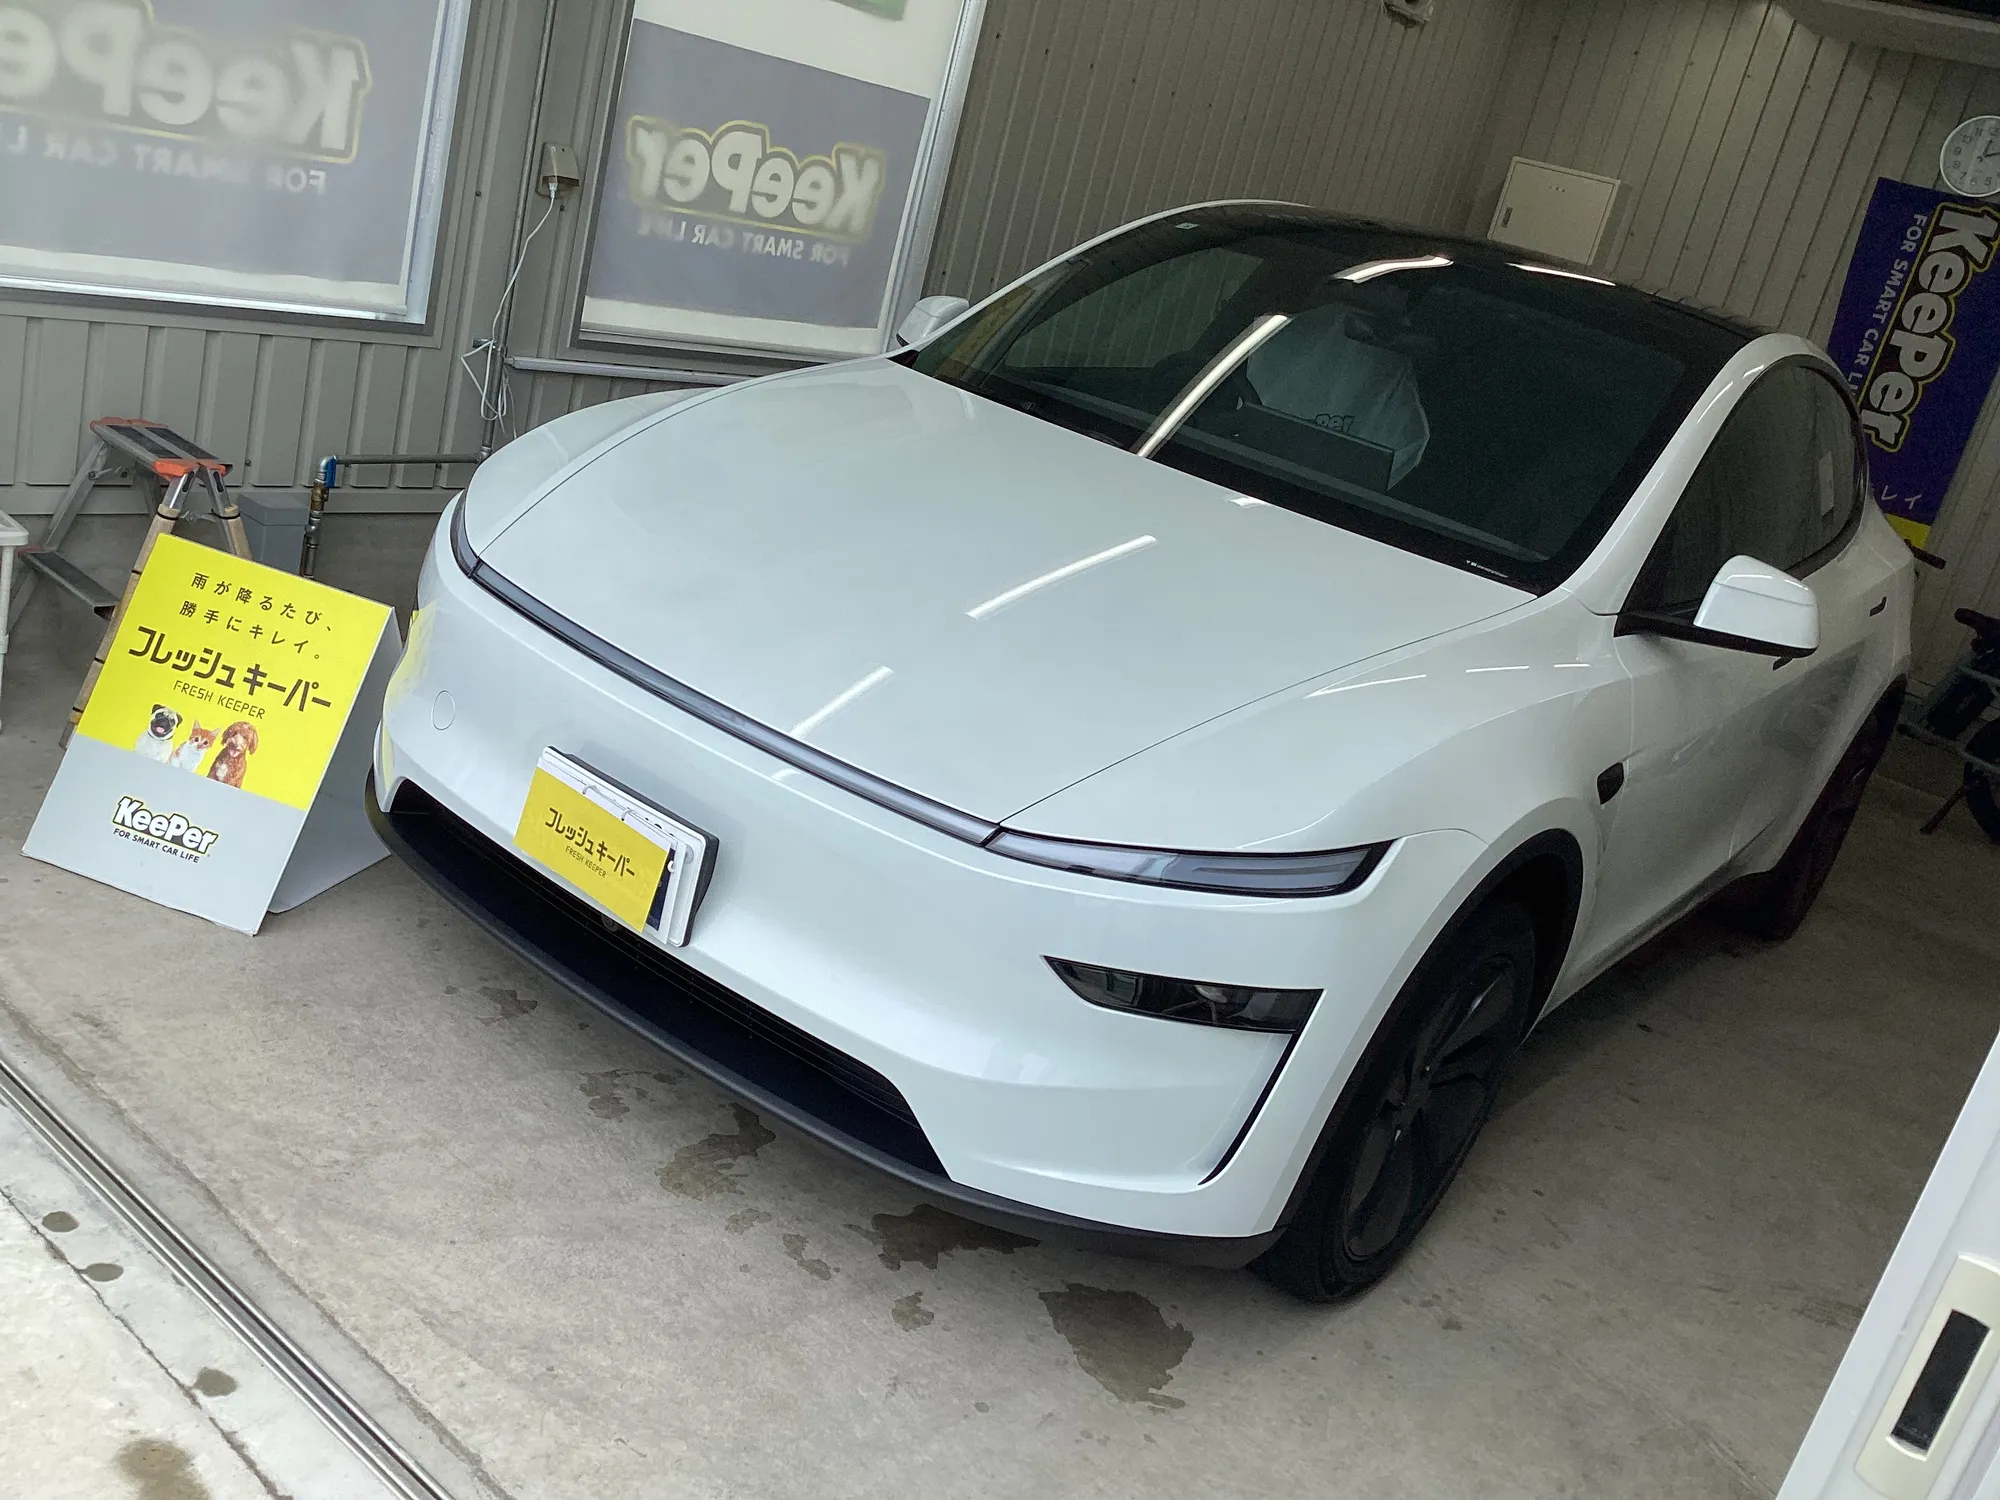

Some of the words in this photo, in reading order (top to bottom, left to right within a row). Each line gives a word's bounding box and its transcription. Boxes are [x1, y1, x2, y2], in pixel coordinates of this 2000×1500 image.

[1900, 213, 1928, 253] FOR
[1872, 258, 1909, 324] SMART
[1854, 327, 1879, 366] CAR
[1861, 208, 2000, 445] KeePer
[1880, 484, 1923, 511] レイ
[179, 600, 320, 660] 勝手にキレイ。
[191, 572, 332, 632] 雨が降るたび、
[128, 625, 332, 712] フレッシュキーパー
[173, 680, 214, 702] FRESH
[217, 695, 266, 720] KEEPER
[112, 795, 219, 854] KeePer
[113, 828, 130, 840] FOR
[132, 834, 161, 850] SMART
[161, 845, 179, 856] CAR
[179, 850, 200, 864] LIFE
[545, 807, 635, 877] フレッシュキーパー
[565, 845, 584, 863] FRESH
[584, 858, 607, 878] KEEPER
